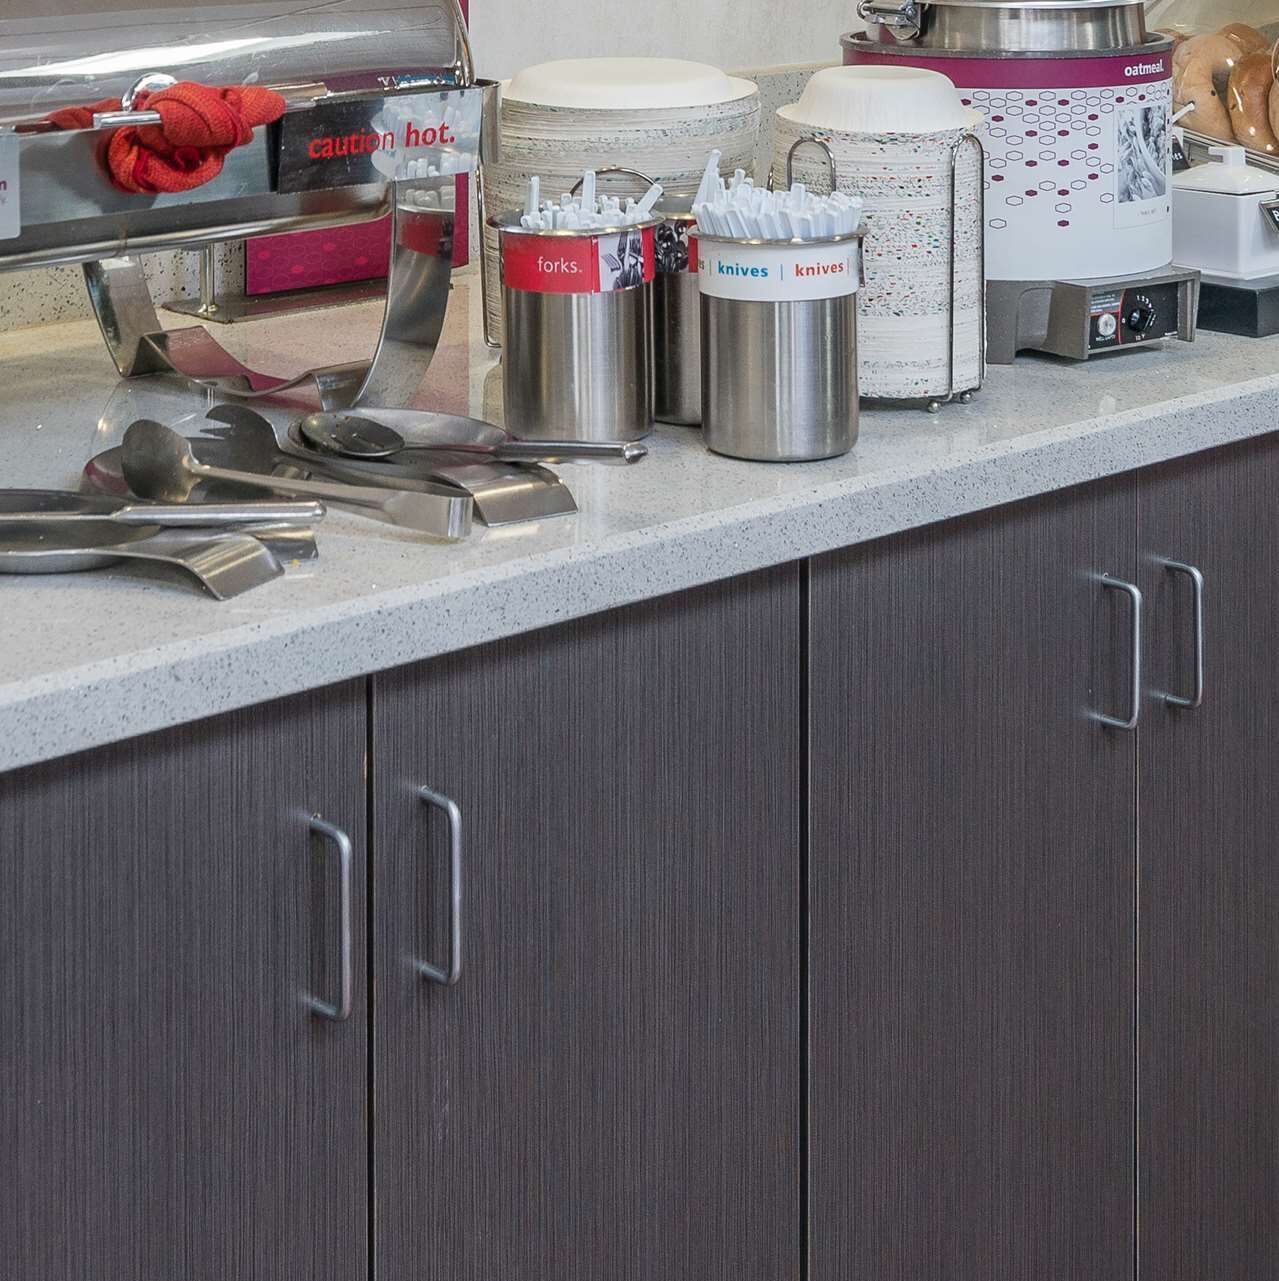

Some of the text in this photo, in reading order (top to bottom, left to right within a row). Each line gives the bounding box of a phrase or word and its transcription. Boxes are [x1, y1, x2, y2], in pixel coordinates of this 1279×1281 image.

[308, 121, 456, 160] caution hot.
[537, 256, 582, 273] forks.
[718, 260, 768, 277] knives
[795, 262, 844, 277] knives
